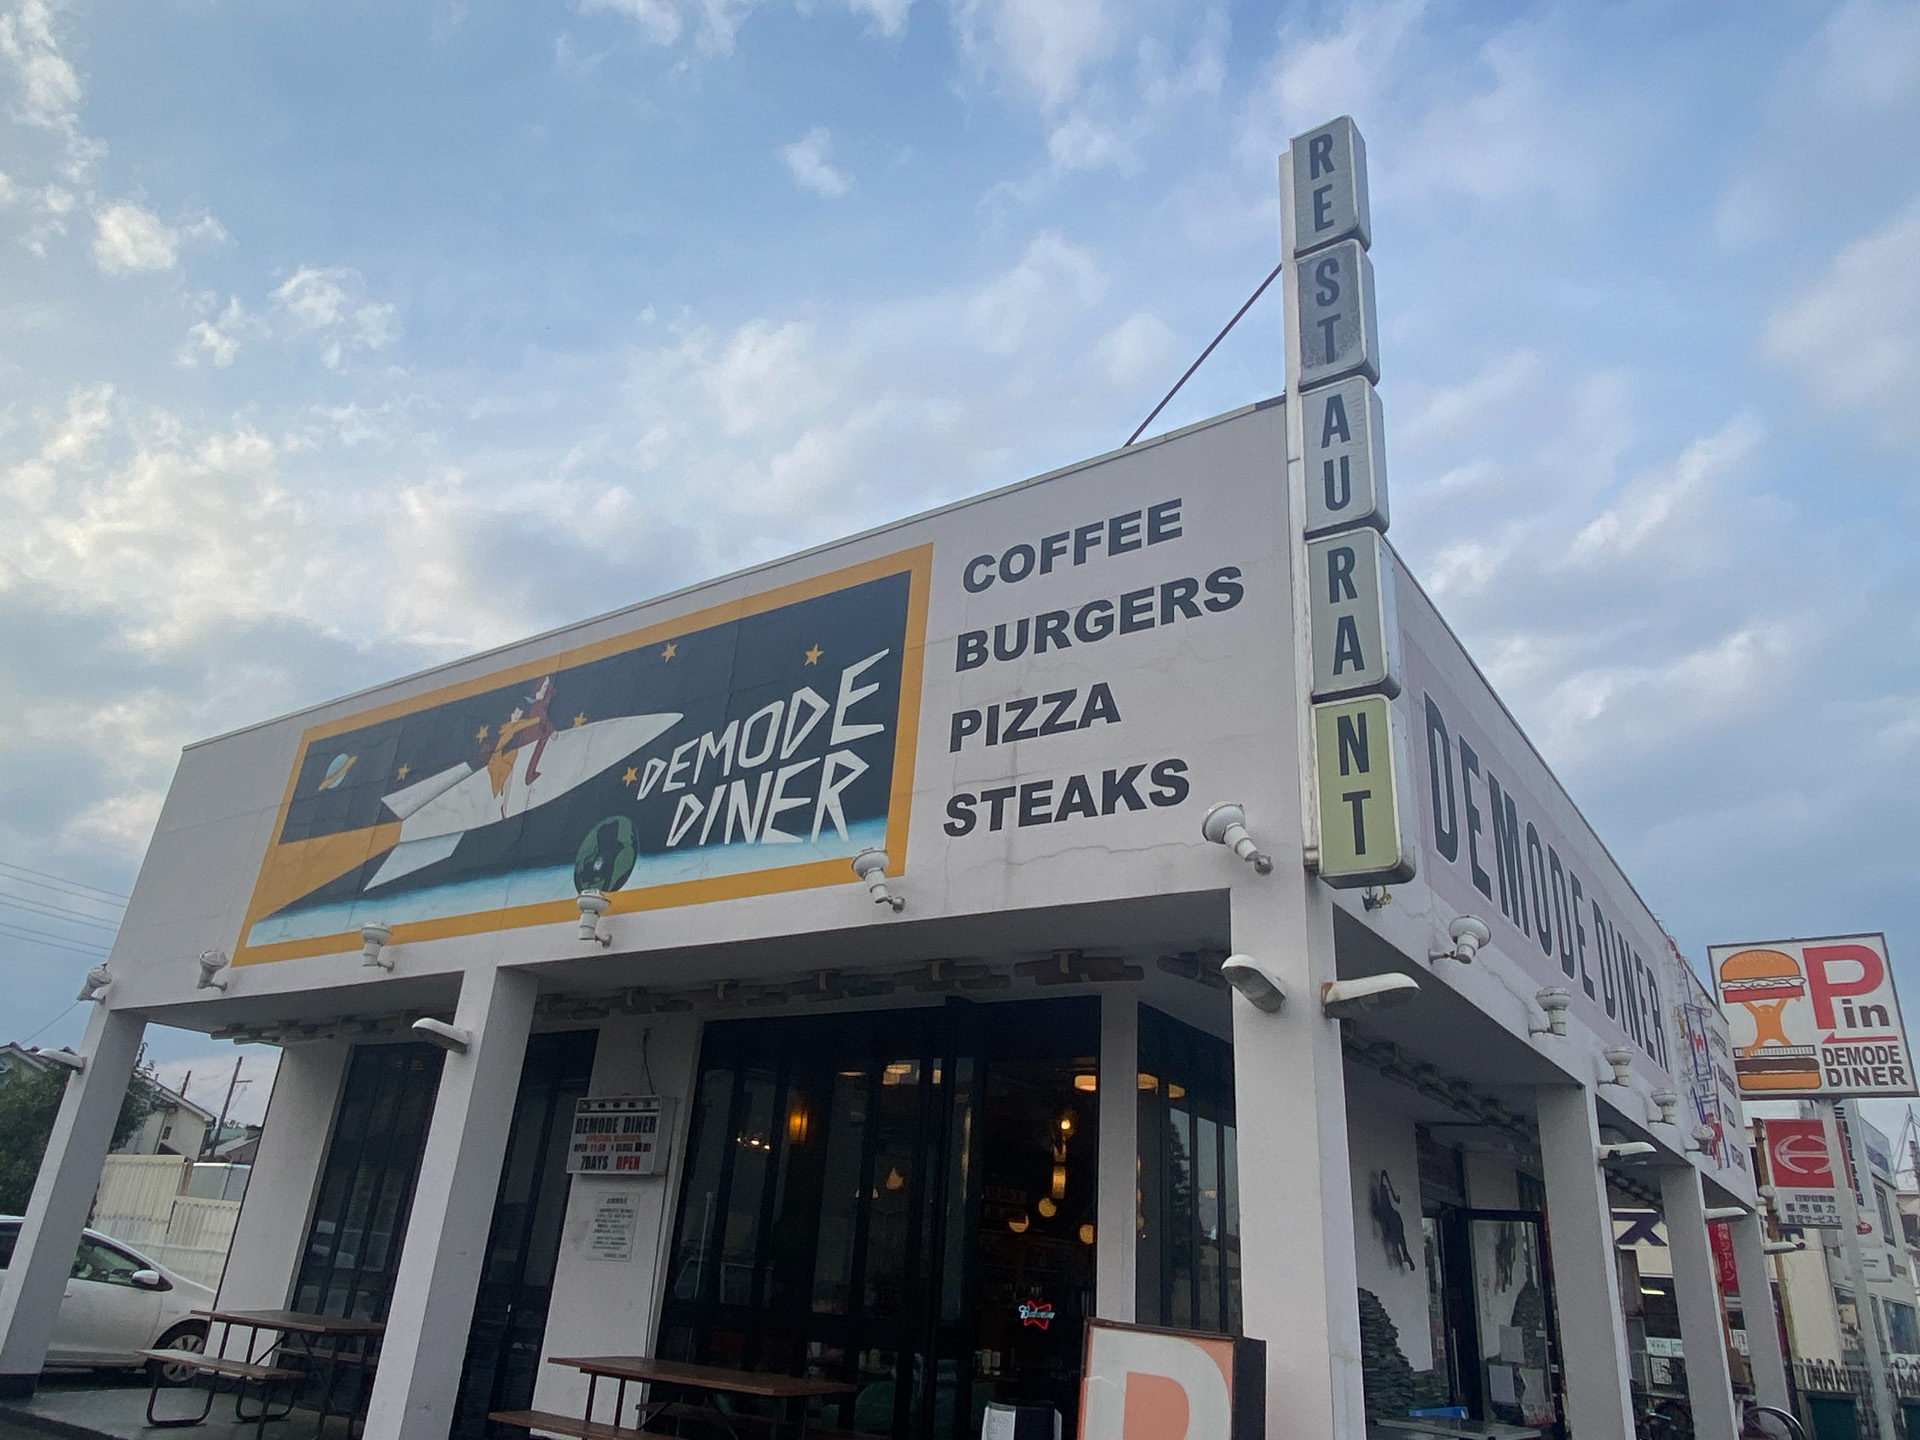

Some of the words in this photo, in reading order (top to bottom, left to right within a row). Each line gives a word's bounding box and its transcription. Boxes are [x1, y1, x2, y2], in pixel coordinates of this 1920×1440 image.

[1309, 132, 1372, 856] RESTAURANT
[963, 497, 1183, 594] COFFEE
[955, 566, 1245, 673] BURGERS
[637, 648, 890, 801] DEMODE
[949, 682, 1122, 754] PIZZA
[665, 748, 870, 848] DINER
[943, 758, 1190, 838] STEAKS
[1424, 690, 1596, 1002] DEMODE
[1592, 897, 1671, 1074] DINER
[1802, 944, 1891, 1030] Pin
[1821, 1045, 1902, 1067] DEMODE
[1826, 1066, 1908, 1088] DINER
[575, 1117, 618, 1134] DEMODE
[623, 1116, 657, 1133] DINER
[616, 1156, 640, 1170] OPEN
